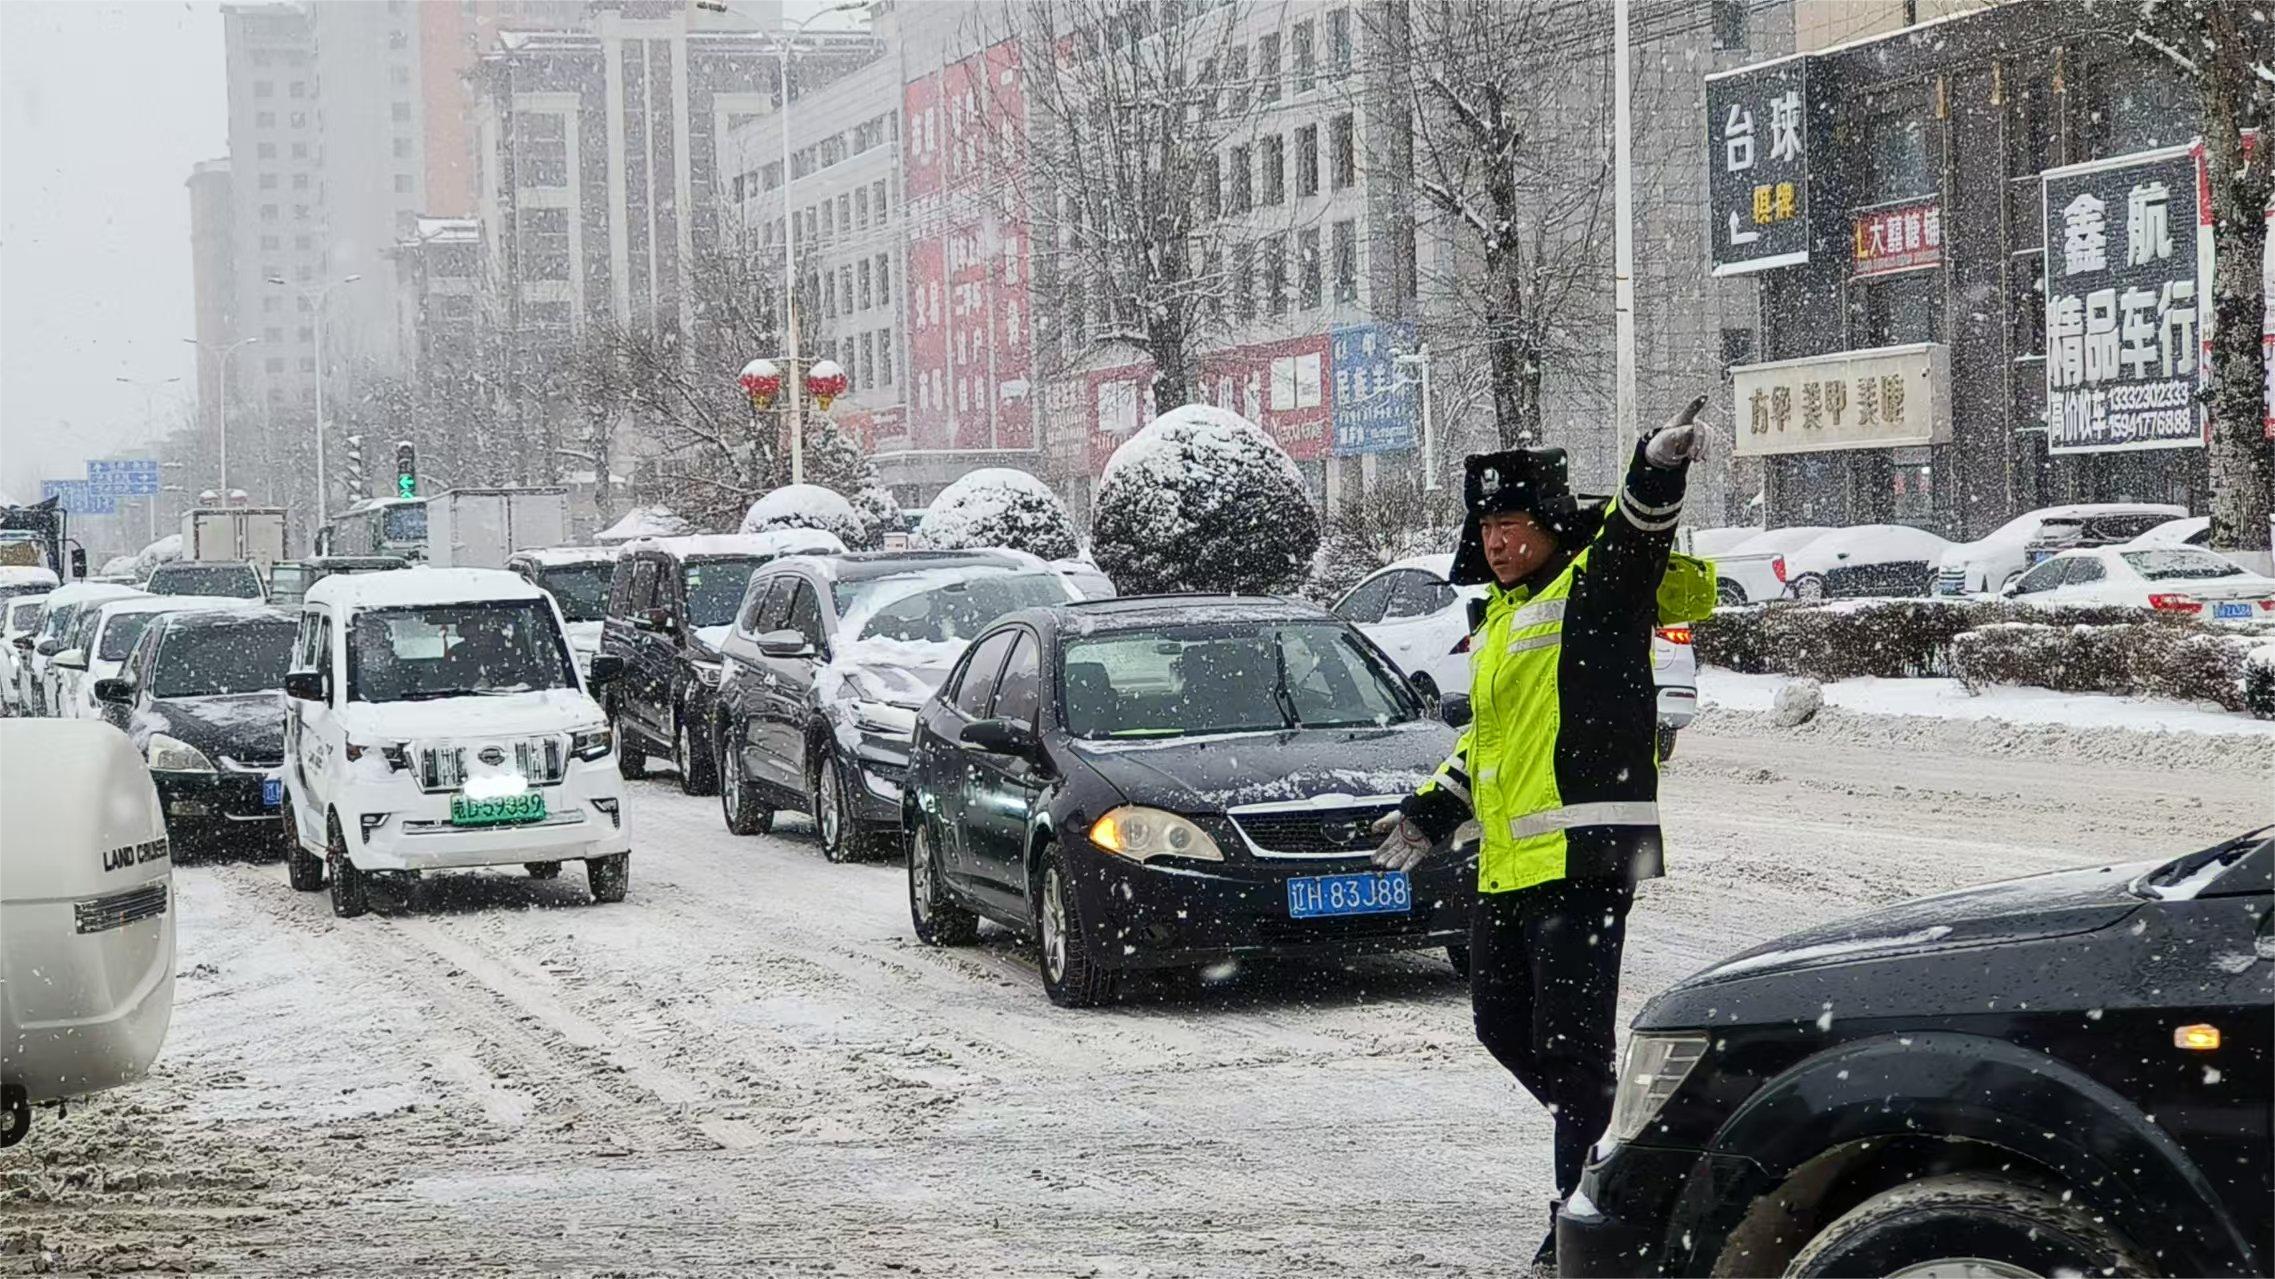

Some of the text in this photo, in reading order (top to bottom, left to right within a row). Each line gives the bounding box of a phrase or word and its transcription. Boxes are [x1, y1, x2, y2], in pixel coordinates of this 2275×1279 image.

[1725, 91, 1801, 172] 台球
[2064, 182, 2173, 276] 鑫航
[2050, 280, 2196, 387] 精品车行
[1802, 380, 1847, 429] 美甲
[2051, 387, 2108, 441] 高价收车
[2109, 379, 2190, 411] 13332302333
[2109, 408, 2192, 439] 15941776888
[103, 846, 134, 873] LAND
